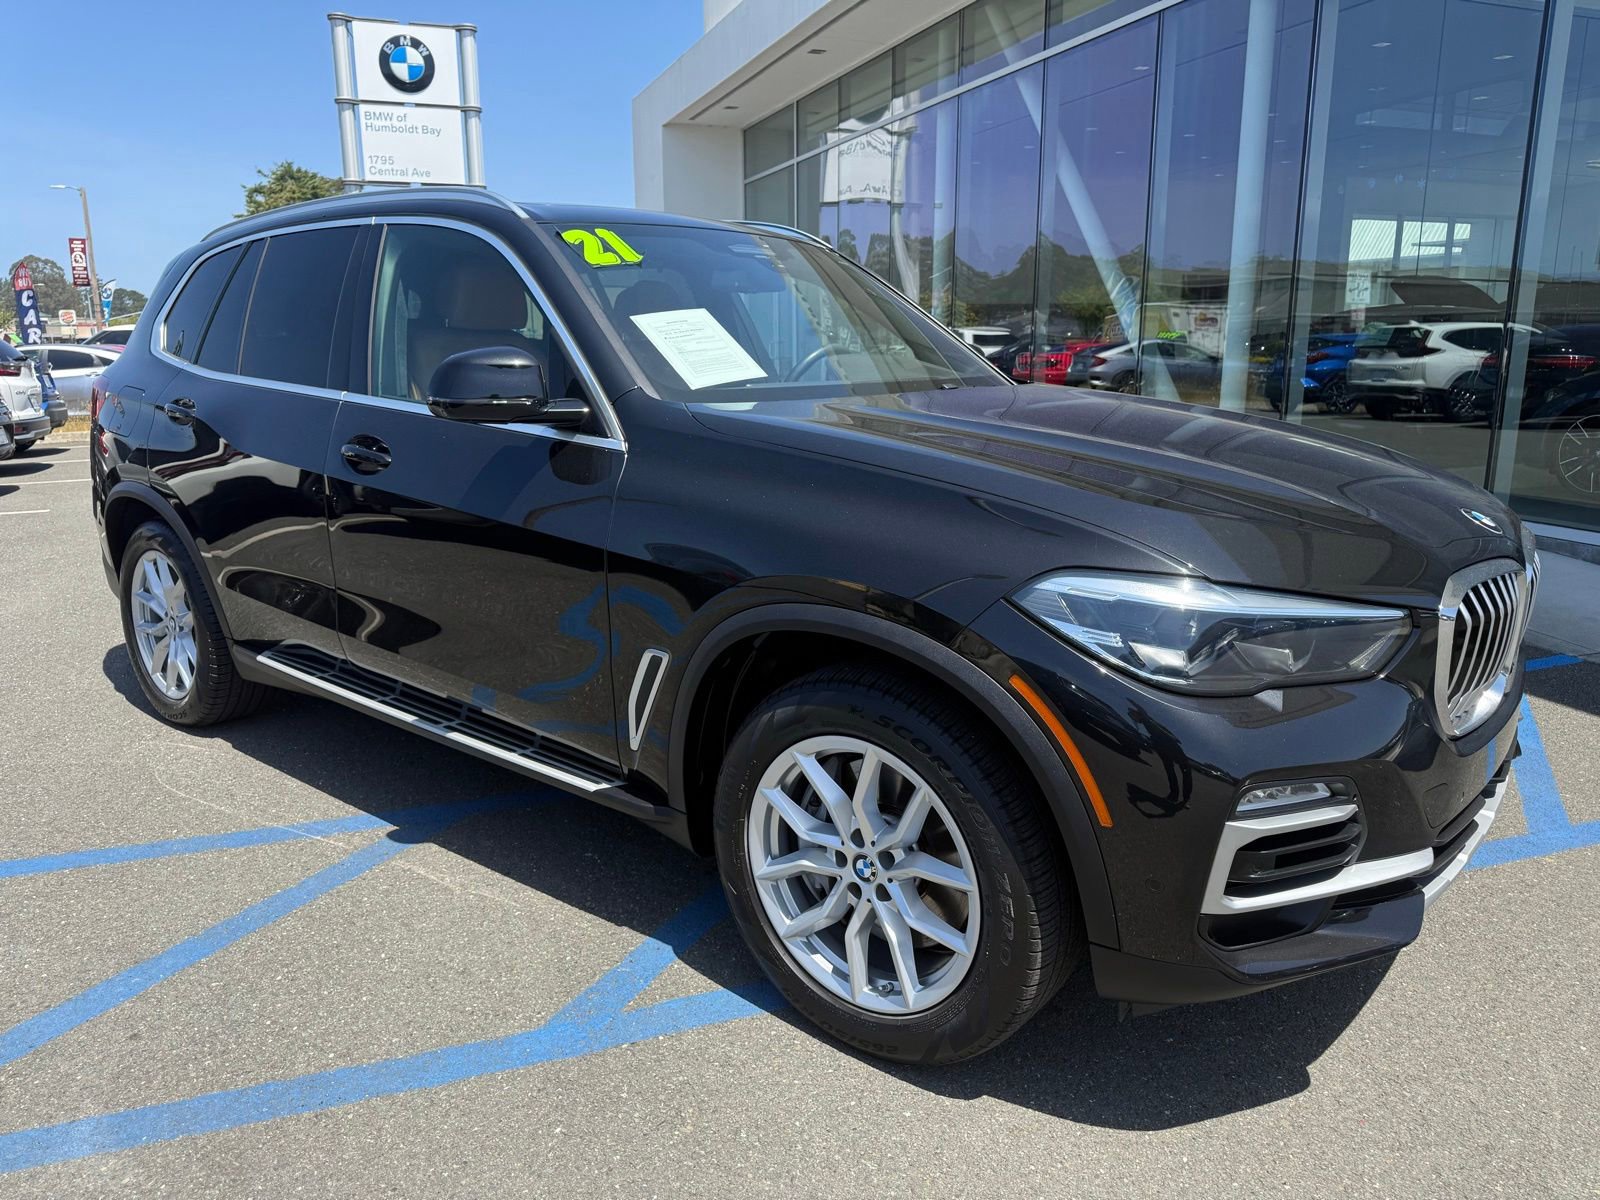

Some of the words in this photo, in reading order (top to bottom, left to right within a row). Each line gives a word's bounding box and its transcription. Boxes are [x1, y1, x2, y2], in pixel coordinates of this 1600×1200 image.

[383, 35, 429, 56] BMW
[364, 111, 394, 122] BMW
[396, 113, 408, 122] of
[365, 122, 420, 134] Humboldt
[421, 125, 442, 137] Bay
[368, 155, 395, 165] 1795
[369, 165, 409, 176] Central
[411, 168, 431, 177] Ave
[561, 228, 644, 266] 21
